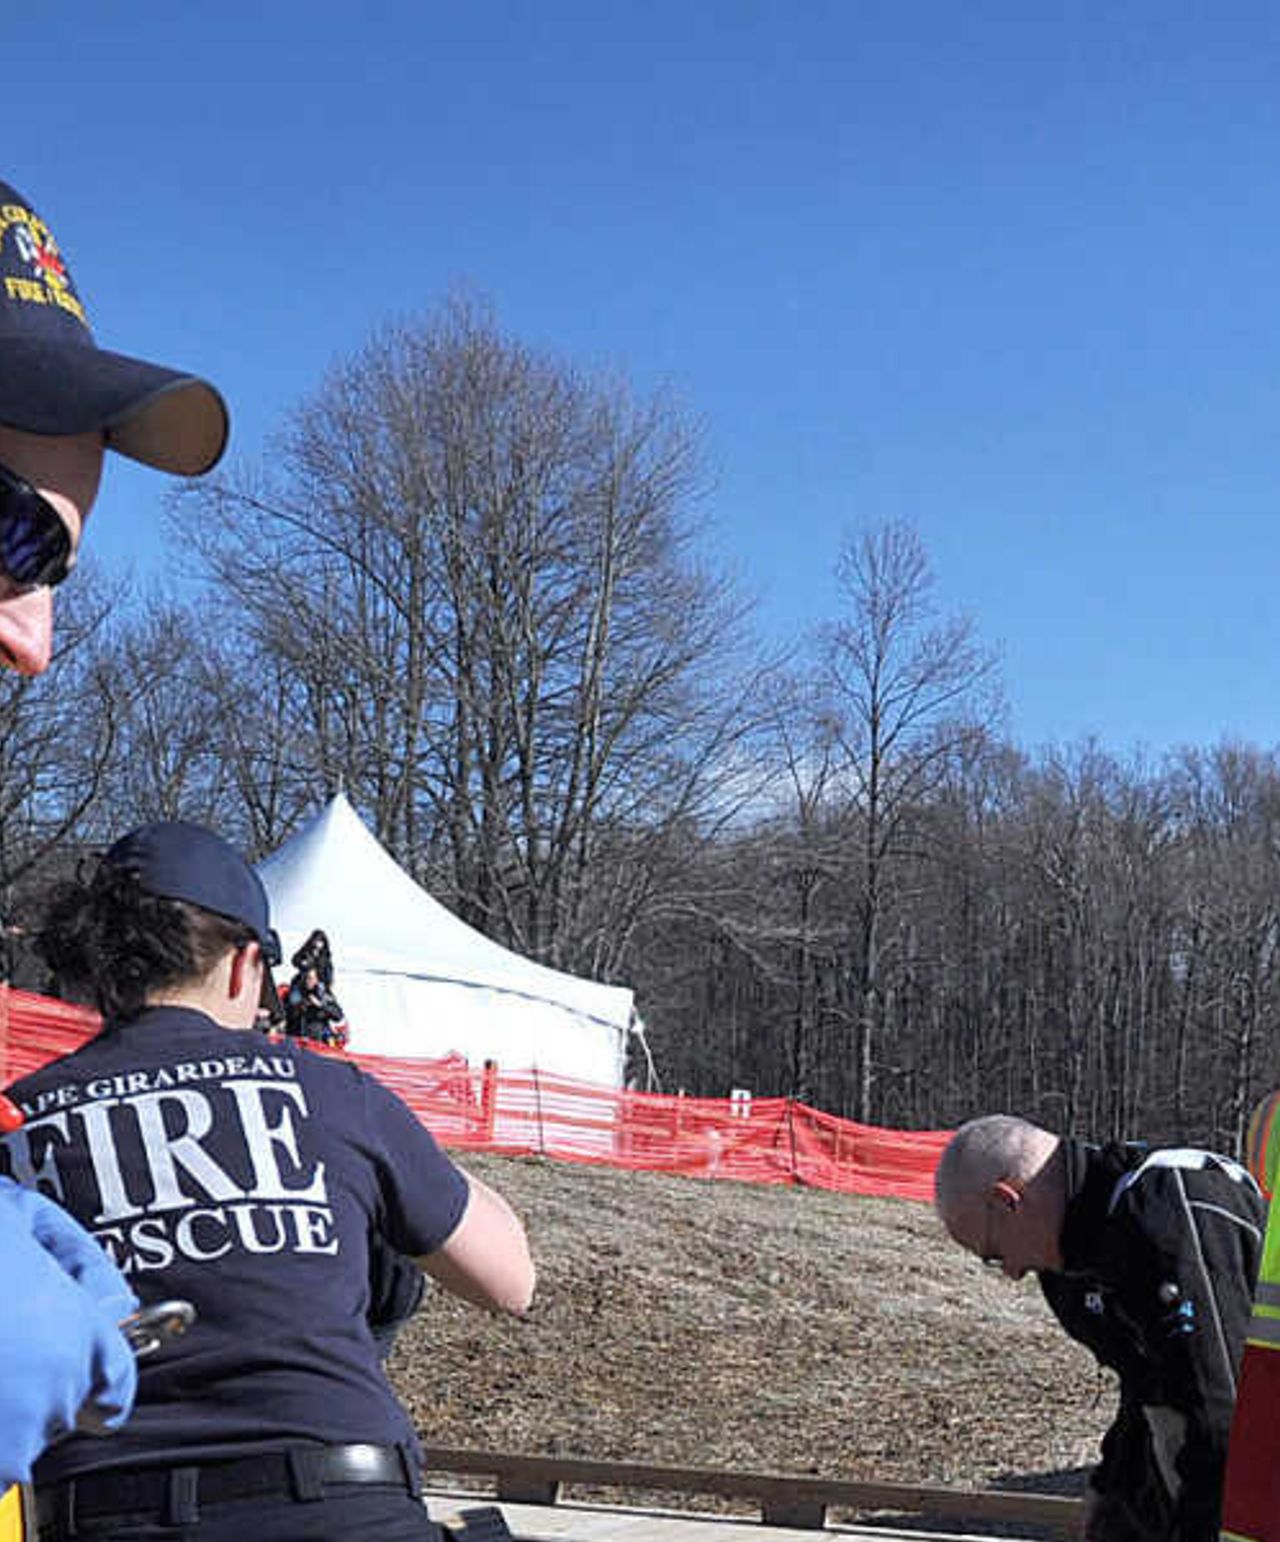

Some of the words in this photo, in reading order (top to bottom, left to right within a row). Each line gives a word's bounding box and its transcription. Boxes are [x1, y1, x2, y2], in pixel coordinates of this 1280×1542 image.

[86, 1056, 296, 1099] GIRARDEAU
[0, 1080, 328, 1223] FIRE
[94, 1203, 339, 1274] ESCUE
